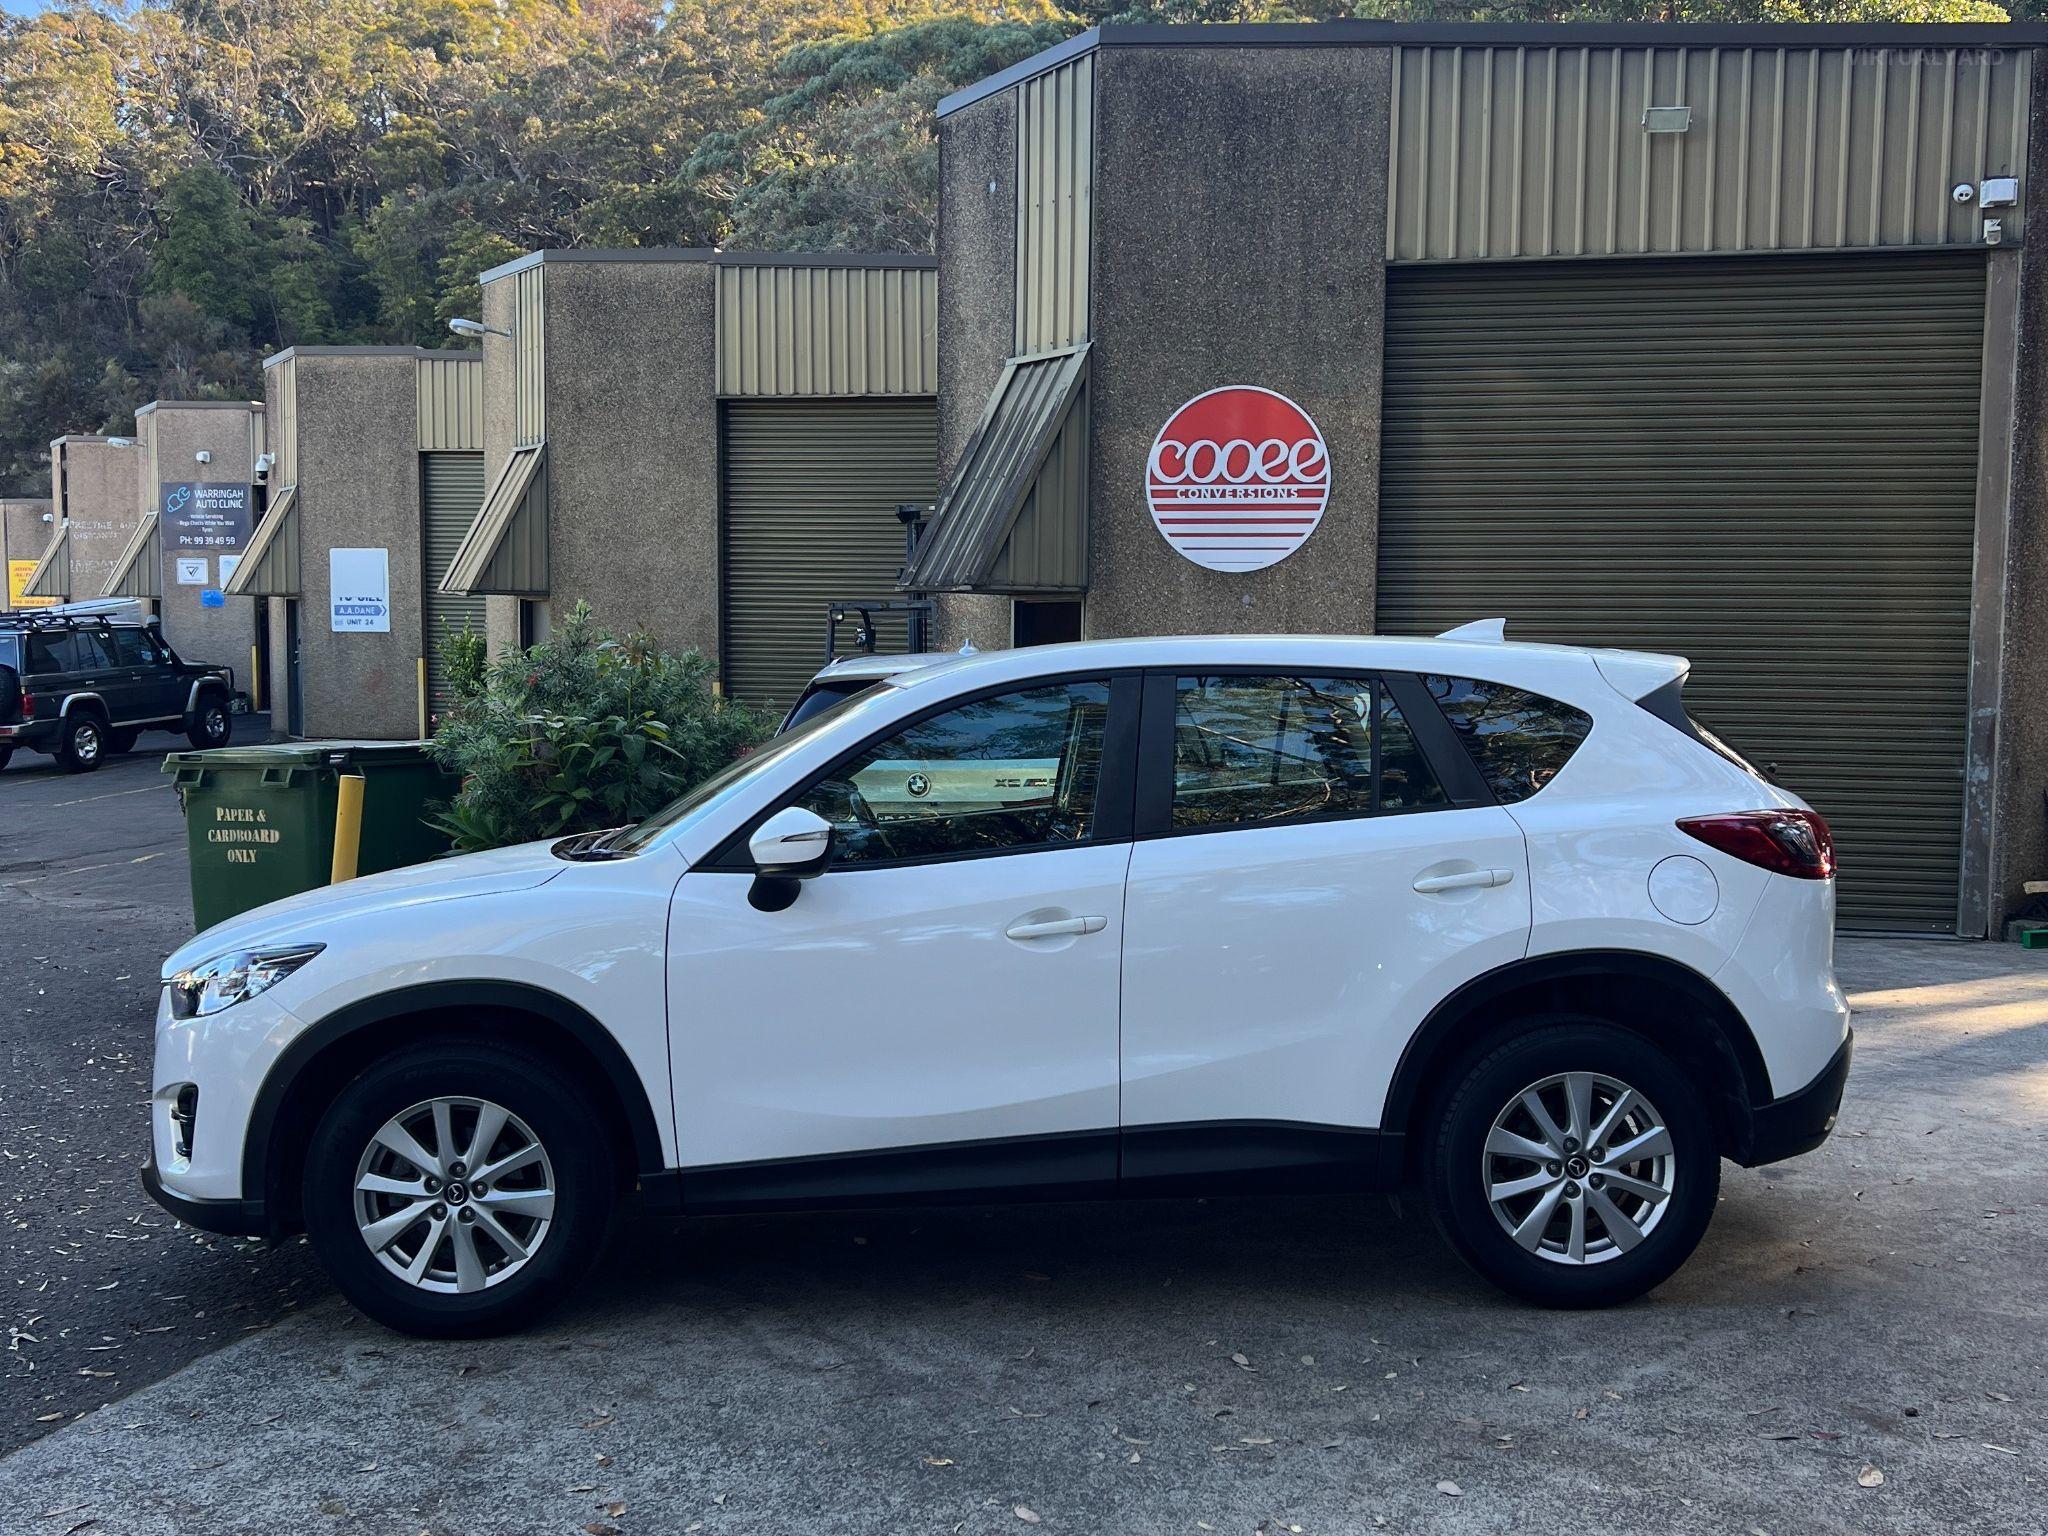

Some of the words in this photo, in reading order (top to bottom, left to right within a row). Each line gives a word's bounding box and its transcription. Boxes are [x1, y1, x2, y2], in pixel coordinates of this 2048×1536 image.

[194, 489, 244, 499] WARRINGAH
[1176, 488, 1299, 499] CONVERSIONS
[195, 499, 218, 509] AUTO
[218, 499, 244, 509] CLINIC
[179, 535, 193, 546] PH:
[194, 536, 204, 545] 99
[204, 536, 214, 545] 39
[214, 536, 225, 545] 49
[225, 536, 236, 545] 59
[216, 807, 254, 822] PAPER
[256, 808, 267, 823] &
[207, 829, 280, 843] CARDBOARD
[227, 849, 257, 863] ONLY
